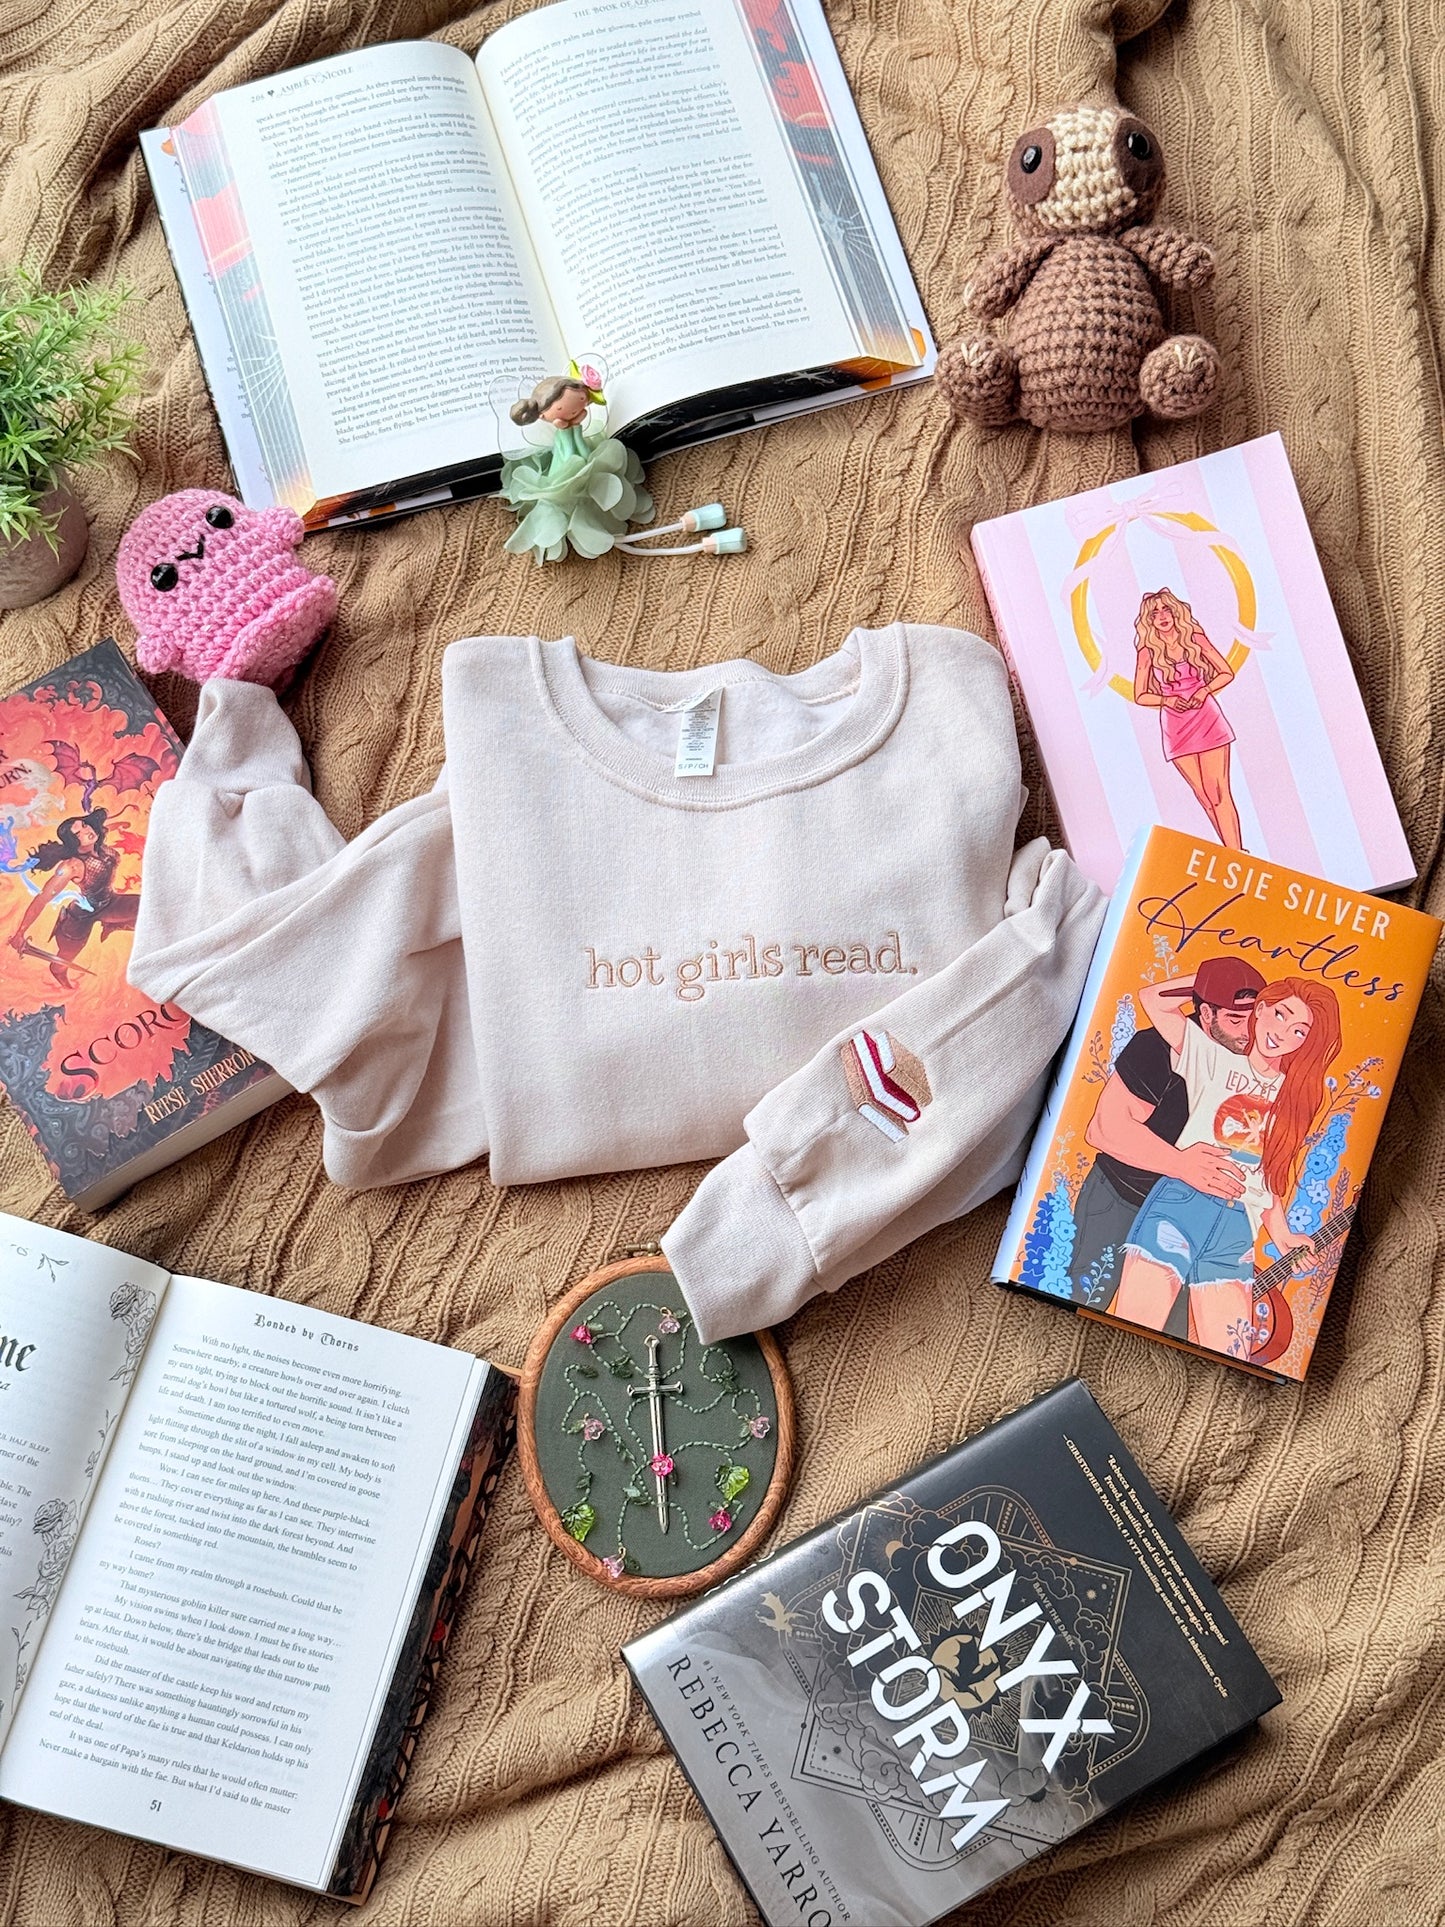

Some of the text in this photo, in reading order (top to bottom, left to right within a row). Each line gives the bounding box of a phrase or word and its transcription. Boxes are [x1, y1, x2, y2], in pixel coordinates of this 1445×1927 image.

[572, 9, 591, 19] THE
[592, 2, 619, 15] BOOK
[279, 77, 310, 96] AMBER
[321, 65, 352, 82] NICOLE
[323, 376, 346, 387] slicing
[346, 371, 357, 380] off
[356, 370, 368, 378] his
[367, 363, 388, 374] head.
[395, 354, 417, 367] rolled
[426, 349, 438, 358] the
[438, 345, 453, 355] end
[453, 342, 462, 351] of
[462, 341, 474, 350] the
[474, 337, 497, 348] couch
[496, 336, 519, 344] before
[635, 352, 657, 365] energy
[665, 345, 677, 353] the
[677, 338, 703, 350] shadow
[703, 333, 726, 343] figures
[726, 329, 740, 337] that
[740, 321, 772, 334] followed.
[770, 319, 786, 327] The
[785, 317, 799, 325] two
[799, 314, 810, 322] my
[1185, 847, 1391, 941] ELSIE SILVER
[585, 931, 919, 1001] hot girls read.
[1137, 881, 1405, 1001] Heartless
[143, 1086, 191, 1126] REESE
[253, 1312, 359, 1352] Bonded by Thorns
[201, 1334, 402, 1398] With no light, the noises become even more horrifying.
[26, 1456, 40, 1467] the
[177, 1405, 396, 1472] Sometime during the night, I fall asleep and awaken to soft
[16, 1484, 32, 1497] The
[179, 1468, 185, 1477] I
[185, 1471, 200, 1480] can
[200, 1475, 214, 1484] see
[214, 1477, 228, 1488] for
[227, 1482, 250, 1494] miles
[250, 1488, 262, 1499] up
[261, 1489, 282, 1503] here.
[281, 1496, 301, 1508] And
[300, 1501, 322, 1514] these
[320, 1508, 370, 1528] purple-black
[132, 1534, 162, 1549] Roses?
[1103, 1474, 1122, 1501] Proud,
[1119, 1499, 1145, 1538] beautiful,
[1141, 1536, 1156, 1553] and
[1151, 1551, 1165, 1568] full
[1160, 1567, 1172, 1577] of
[1166, 1576, 1186, 1604] unique
[1127, 1487, 1145, 1514] Yarros
[1141, 1511, 1154, 1528] has
[1150, 1527, 1173, 1556] created
[1168, 1555, 1184, 1577] some
[1181, 1576, 1206, 1612] awesome
[119, 1579, 137, 1592] That
[136, 1586, 180, 1603] mysterious
[179, 1598, 207, 1610] goblin
[207, 1602, 230, 1616] killer
[229, 1611, 247, 1622] sure
[247, 1616, 277, 1629] carried
[275, 1624, 290, 1633] me
[289, 1627, 296, 1635] a
[296, 1627, 316, 1642] long
[1032, 1581, 1076, 1650] BRAVE THE DARK.
[1099, 1492, 1124, 1530] PAOLINI,
[1126, 1537, 1142, 1555] NYT
[1137, 1554, 1163, 1593] bestselling
[1159, 1591, 1177, 1615] author
[1174, 1615, 1184, 1625] of
[1179, 1623, 1190, 1637] the
[1187, 1635, 1215, 1677] Inheritance
[1212, 1676, 1228, 1698] Cycle
[926, 1520, 1116, 1773] ONYX
[93, 1654, 310, 1722] Did the master of the castle keep his word and return my
[821, 1570, 1012, 1852] STORM
[68, 1729, 298, 1800] It was one of Papa's many rules that he would often mutter:
[666, 1653, 762, 1813] REBECCA
[149, 1798, 162, 1812] 51
[710, 1675, 731, 1700] NEW
[727, 1703, 750, 1737] YORK
[746, 1739, 772, 1778] TIMES
[769, 1780, 820, 1865] BESTSELLING
[816, 1869, 850, 1922] AUTHOR
